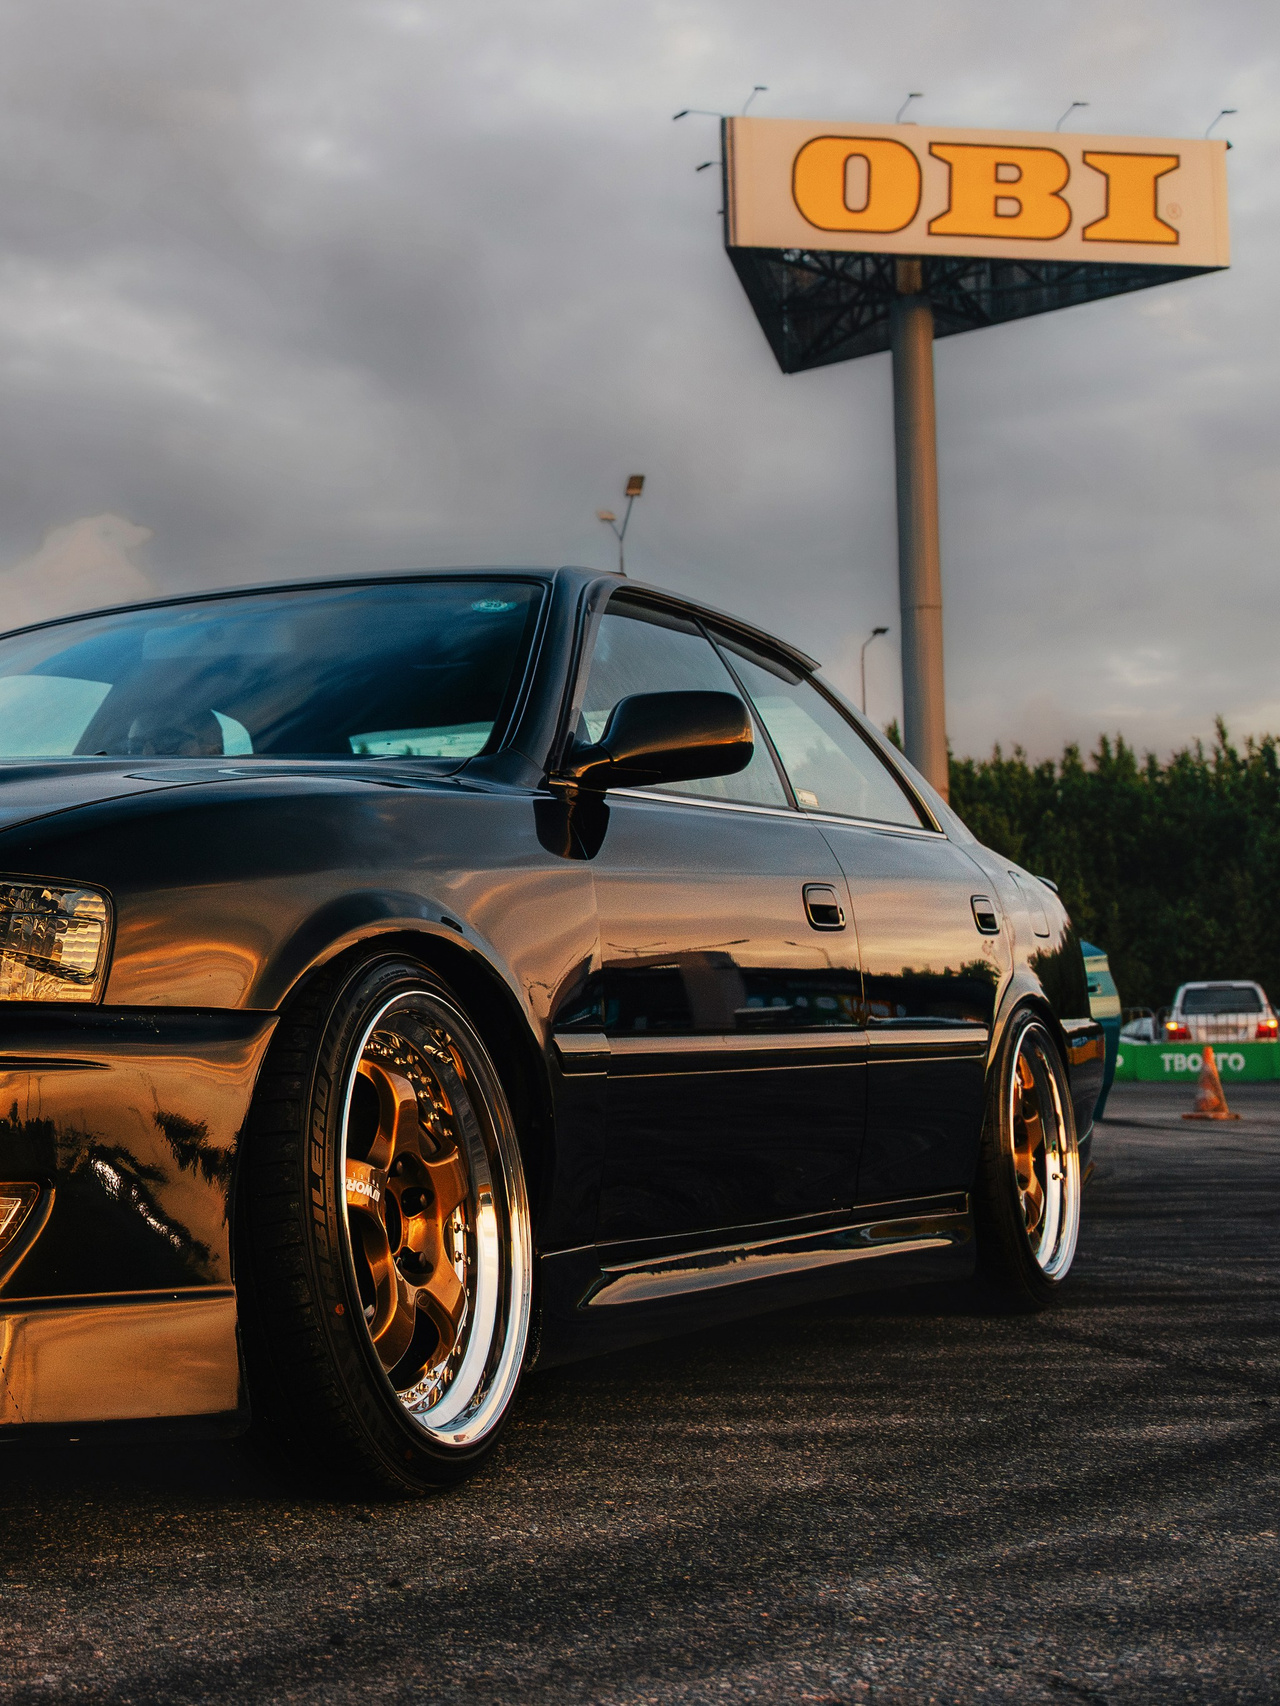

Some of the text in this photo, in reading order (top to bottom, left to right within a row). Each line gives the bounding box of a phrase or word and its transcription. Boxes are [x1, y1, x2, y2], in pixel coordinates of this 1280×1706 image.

[792, 135, 1181, 244] OBI
[1160, 1052, 1246, 1073] ТВОГО
[345, 1178, 373, 1198] WOR
